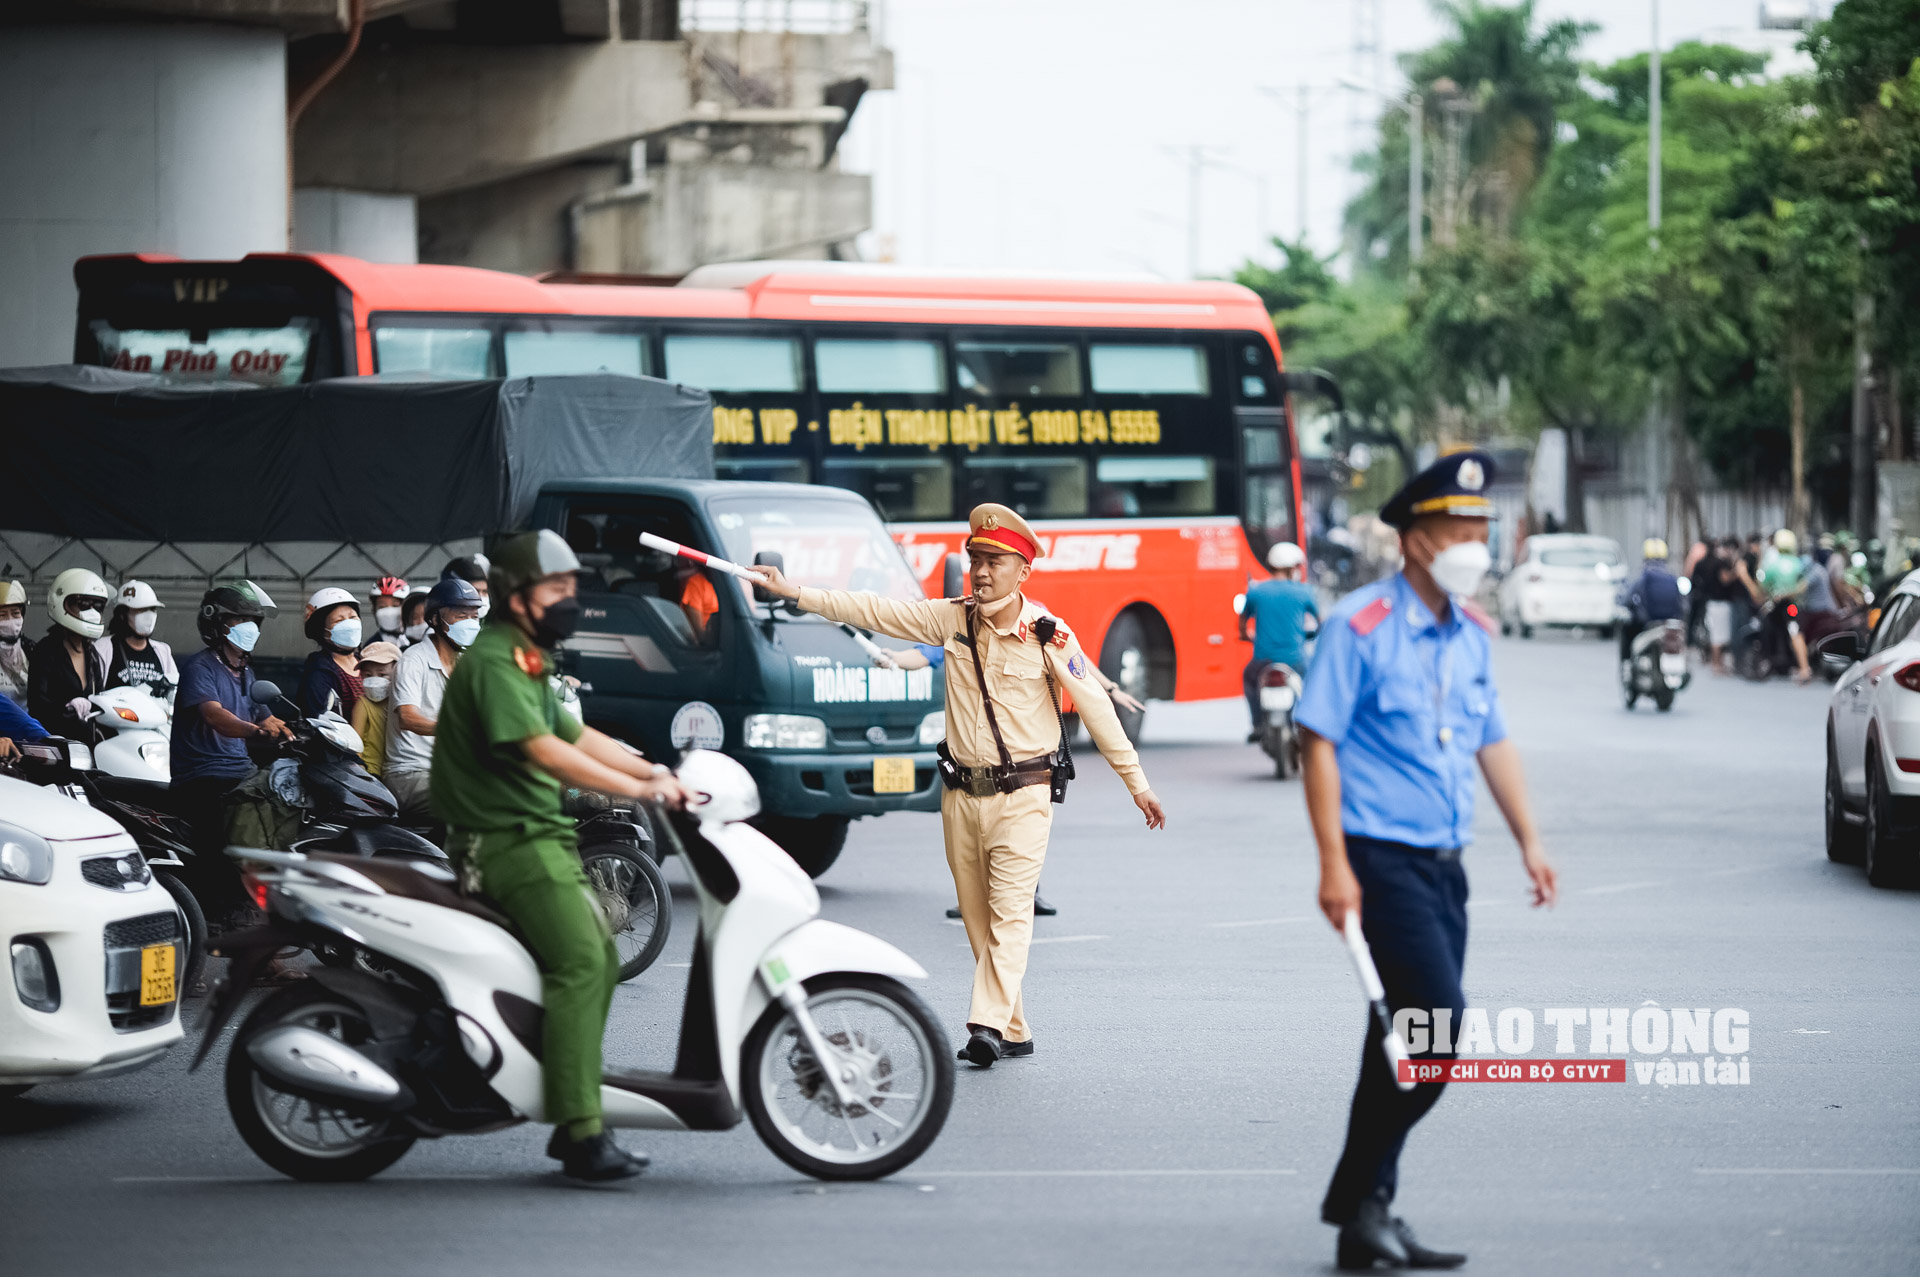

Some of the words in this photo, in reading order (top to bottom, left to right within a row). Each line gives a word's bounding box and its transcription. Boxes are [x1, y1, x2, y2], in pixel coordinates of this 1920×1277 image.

[173, 278, 229, 303] VIP
[112, 349, 152, 372] An
[162, 349, 217, 373] Phú
[759, 408, 798, 444] VIP
[828, 401, 882, 451] ĐIỆN
[885, 408, 948, 451] THOẠI
[950, 402, 990, 452] ĐẶT
[1030, 408, 1079, 444] 1900
[1080, 408, 1109, 444] 54
[1109, 408, 1161, 444] 5555
[813, 661, 867, 703] HOÀNG
[868, 666, 907, 702] MINH
[907, 665, 933, 702] HUY
